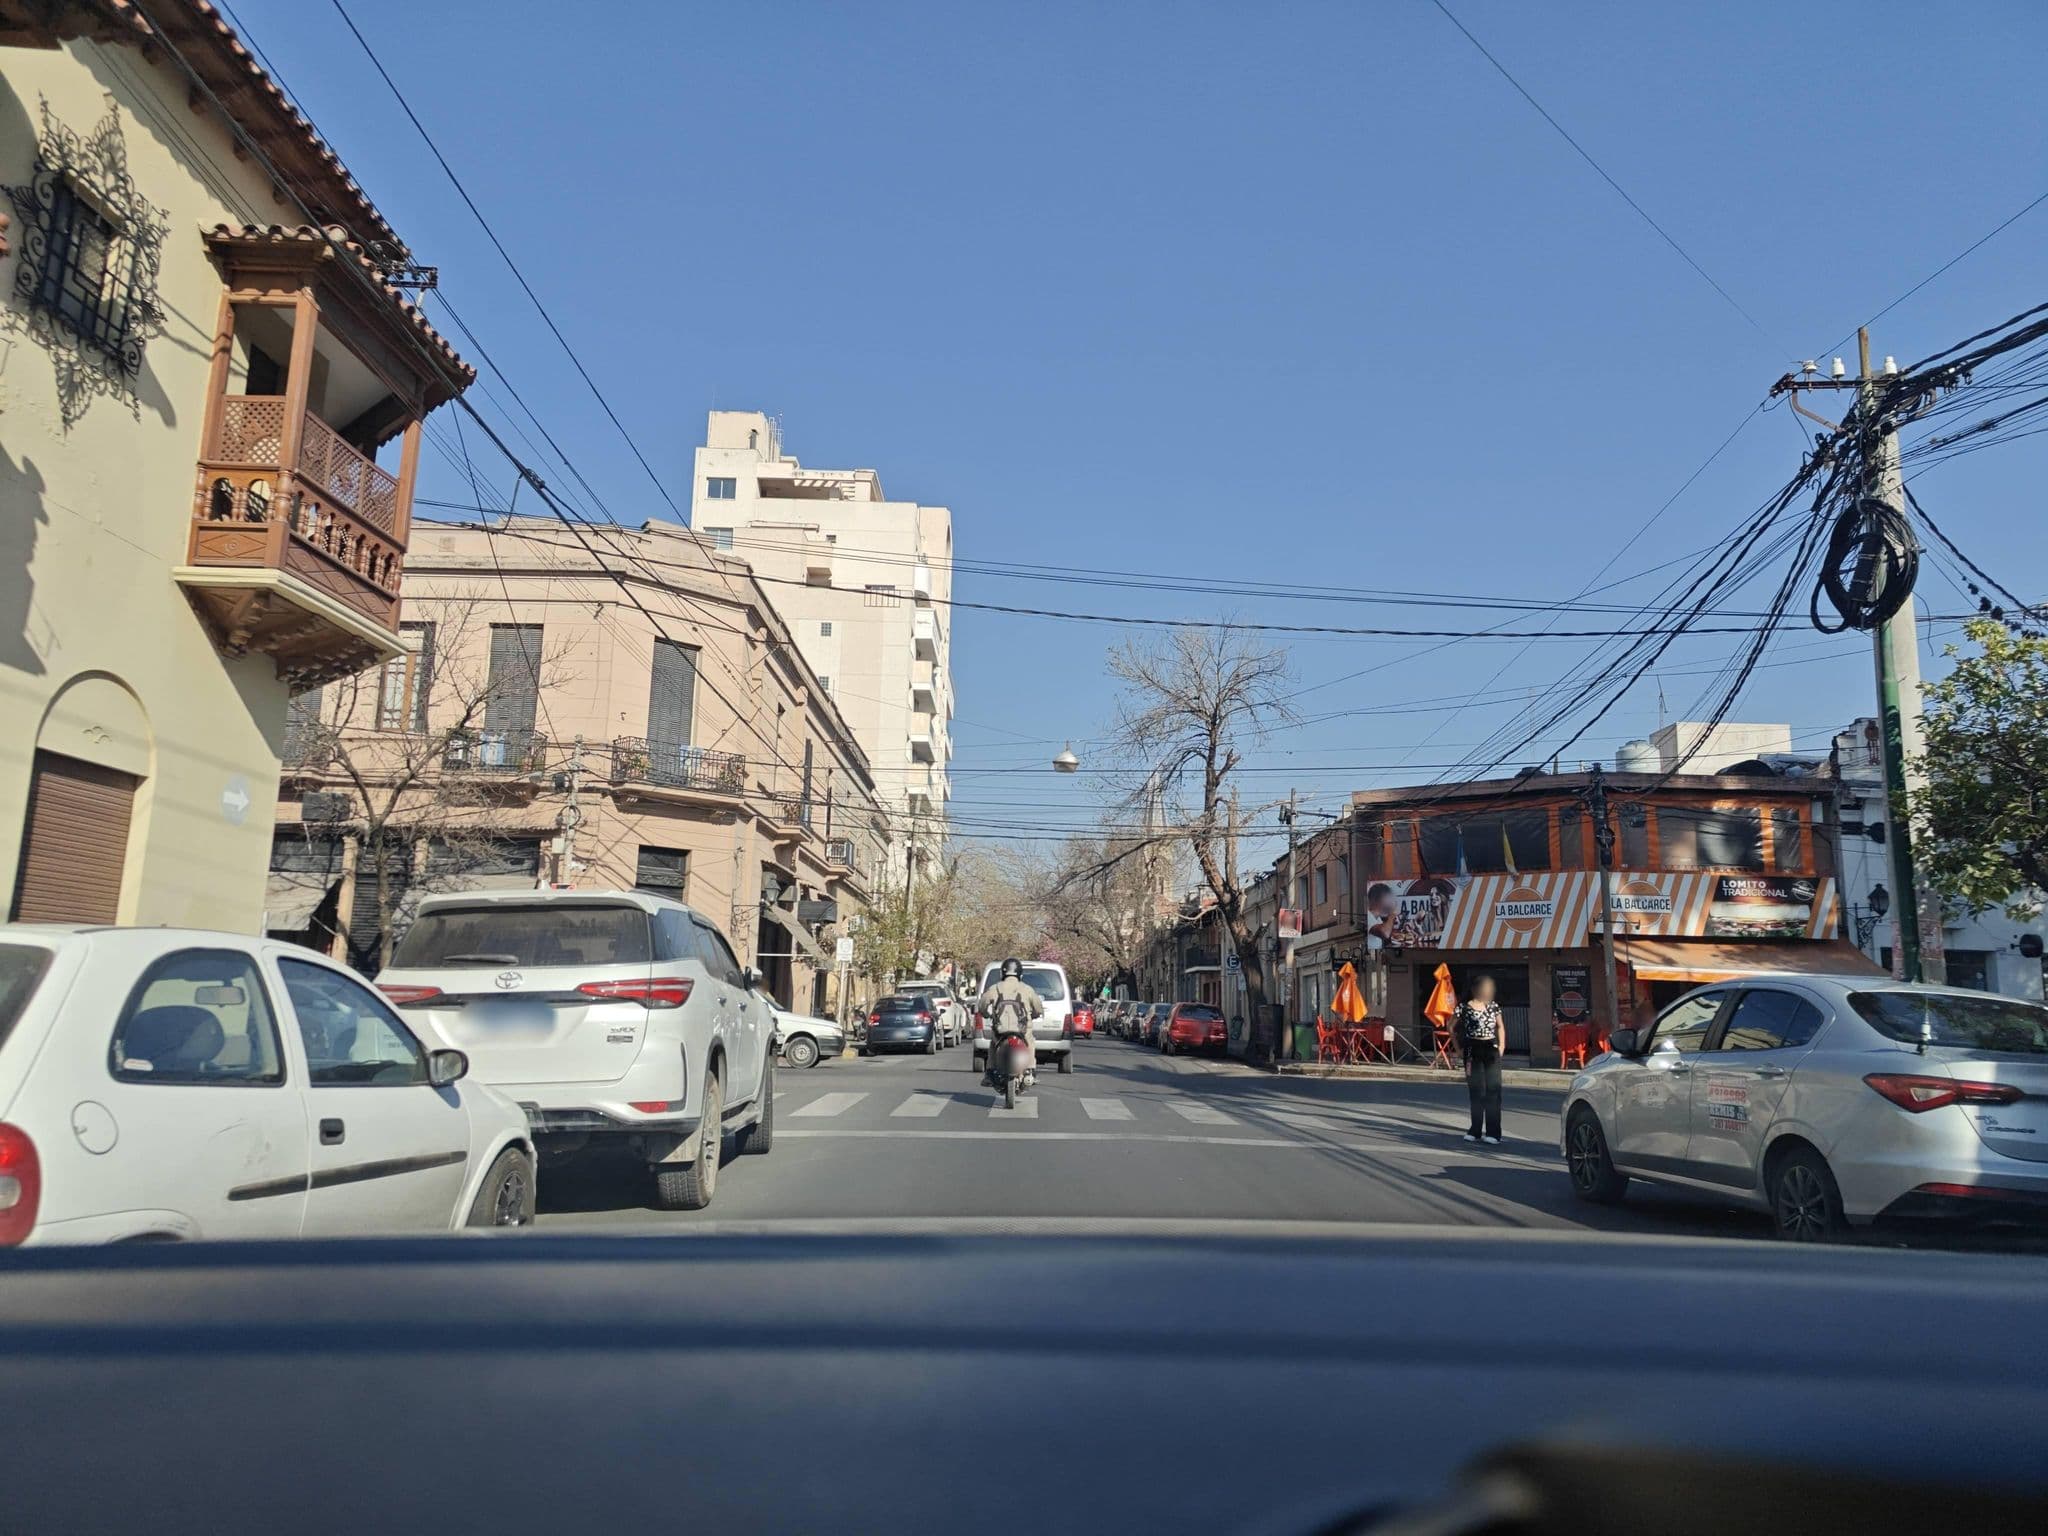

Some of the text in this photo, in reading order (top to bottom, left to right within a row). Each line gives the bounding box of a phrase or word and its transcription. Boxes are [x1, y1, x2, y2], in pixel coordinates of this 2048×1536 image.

[1723, 879, 1766, 888] LOMITO
[1723, 888, 1788, 897] TRADICIONAL
[1611, 898, 1671, 910] LA BALCARCE
[1495, 903, 1552, 916] LA BALCARCE
